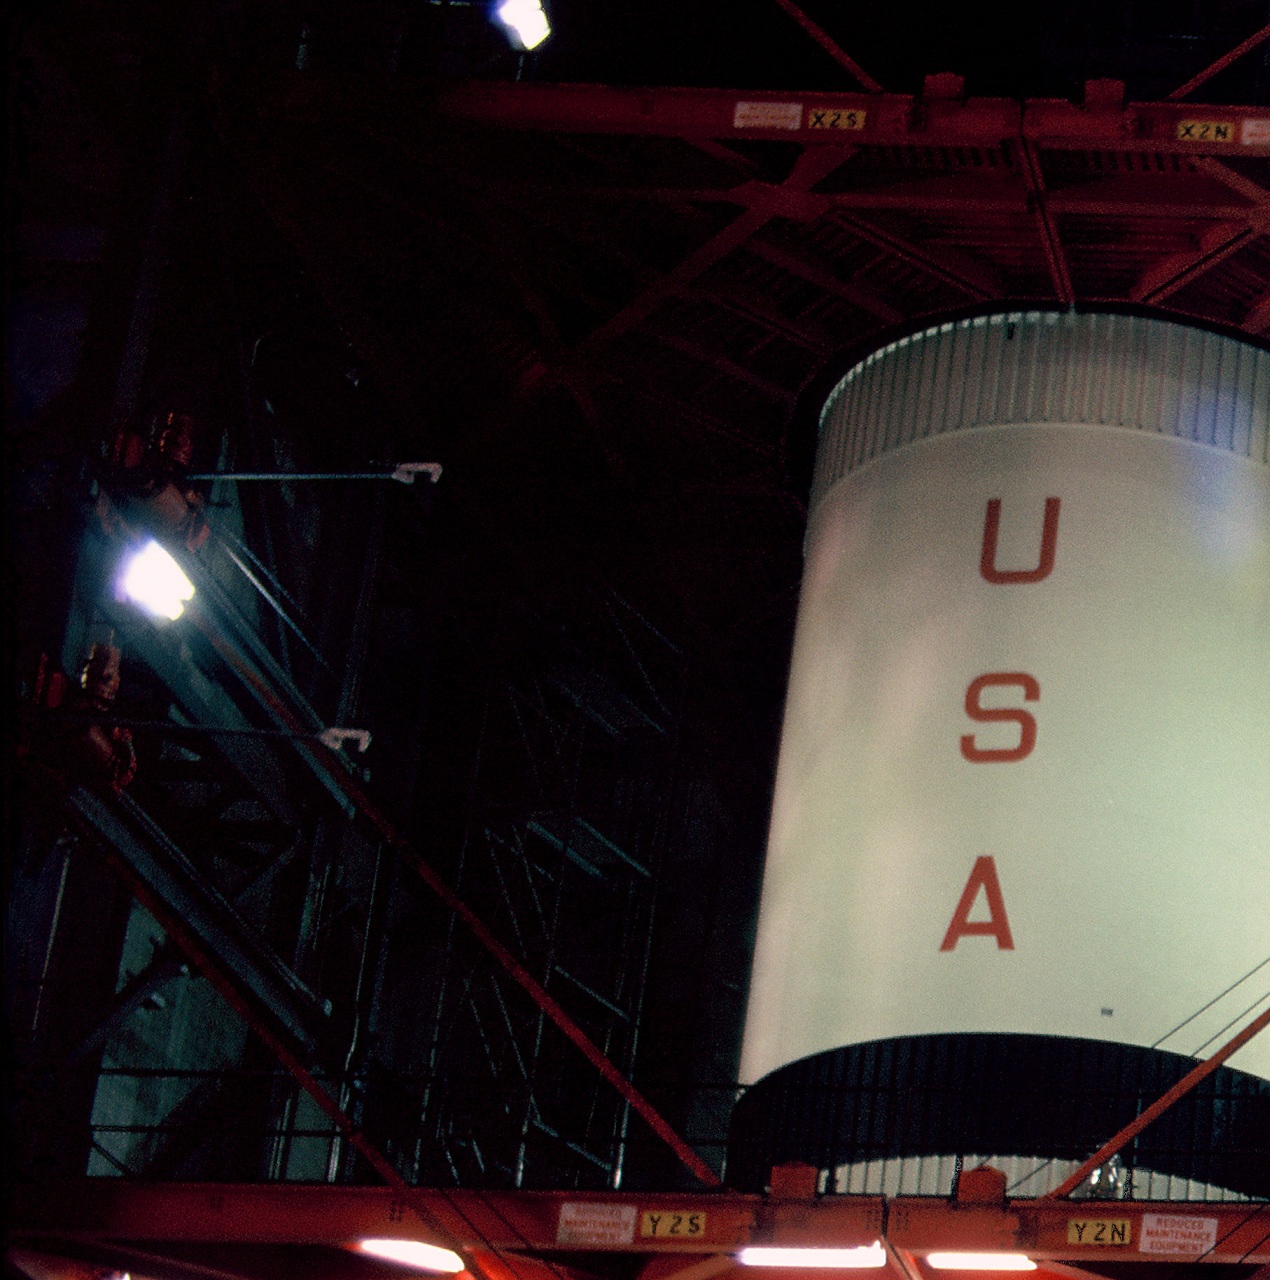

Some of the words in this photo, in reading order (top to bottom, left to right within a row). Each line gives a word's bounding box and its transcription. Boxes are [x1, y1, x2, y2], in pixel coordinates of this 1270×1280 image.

[650, 1215, 700, 1235] Y2S
[1156, 1218, 1204, 1230] REDUCED
[1075, 1223, 1125, 1242] Y2N
[1145, 1229, 1212, 1242] MAINTENANCE
[1149, 1240, 1204, 1251] EQUIPMENT
